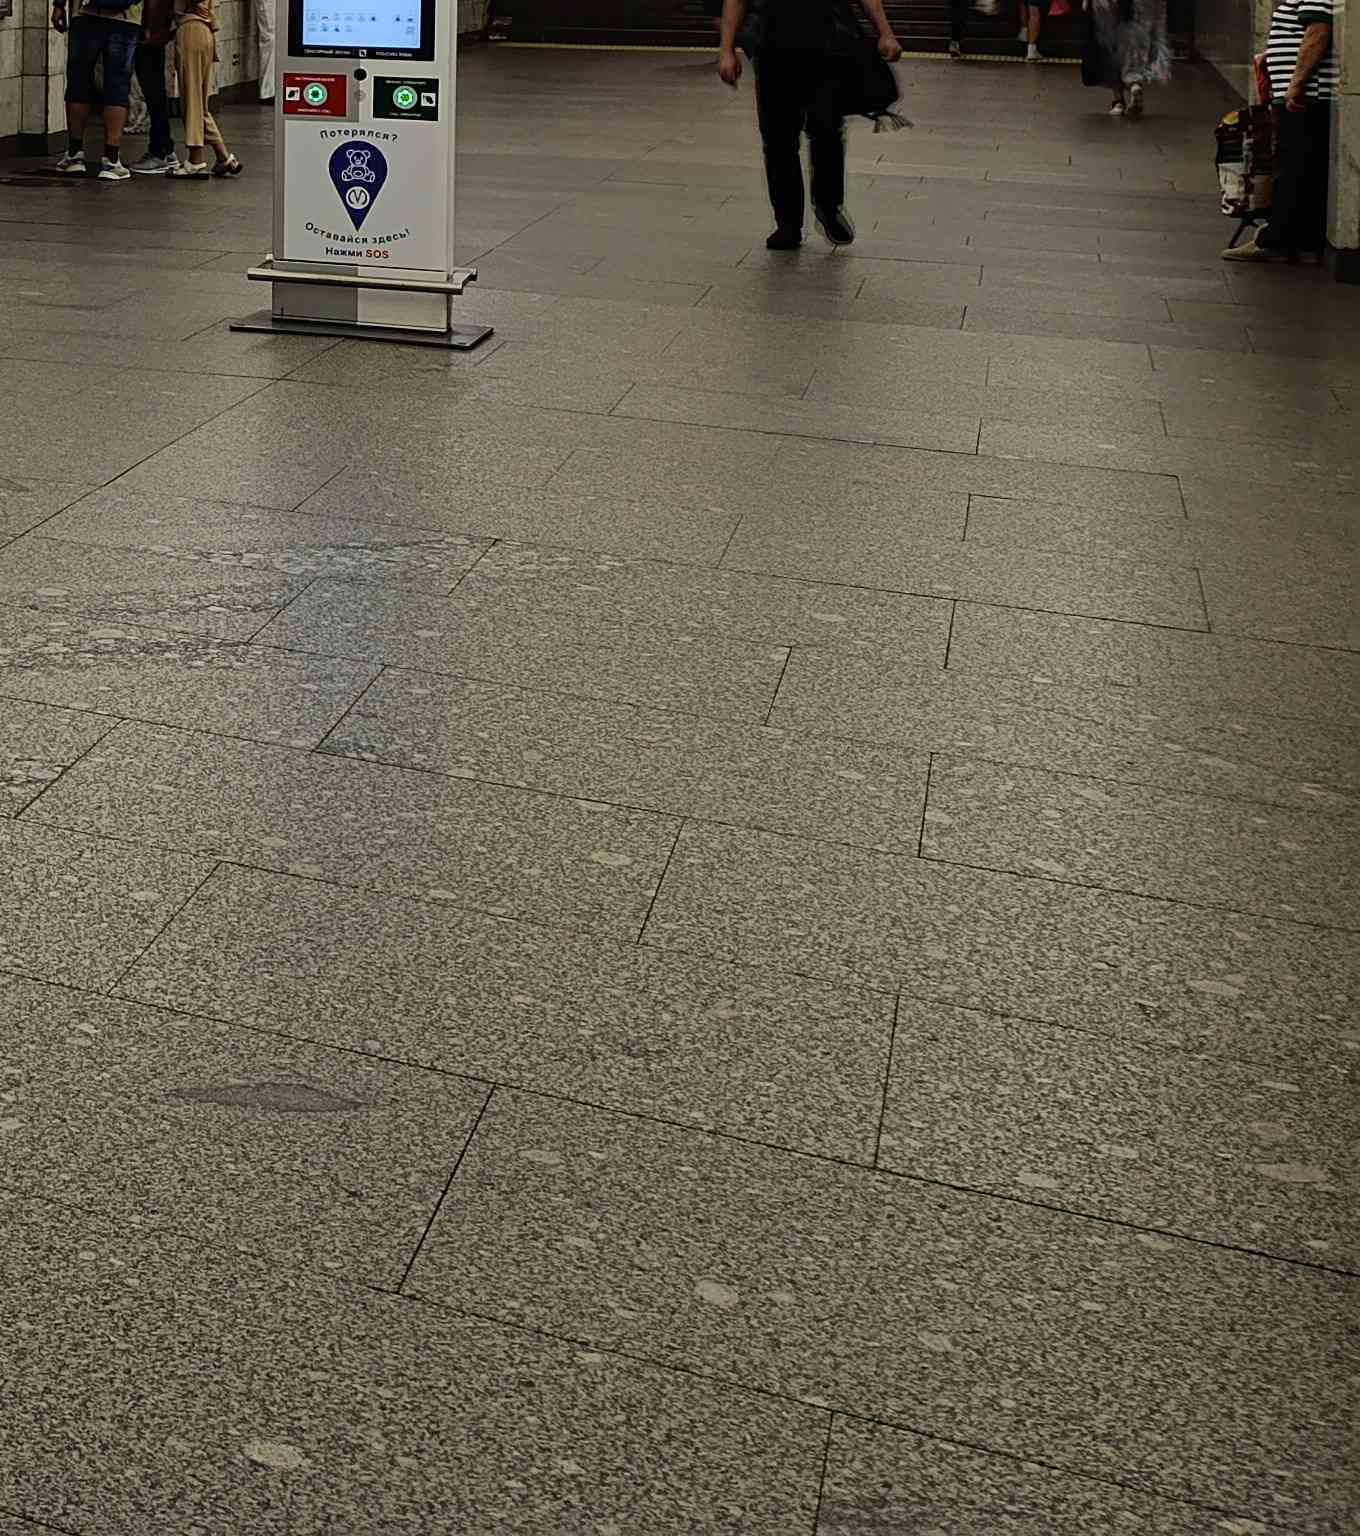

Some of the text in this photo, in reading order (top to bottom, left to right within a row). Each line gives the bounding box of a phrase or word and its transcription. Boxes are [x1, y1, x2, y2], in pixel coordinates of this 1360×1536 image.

[319, 128, 399, 144] Потерялся?
[305, 221, 411, 245] Оставайся здесь!
[325, 247, 390, 259] Нажми SOS
